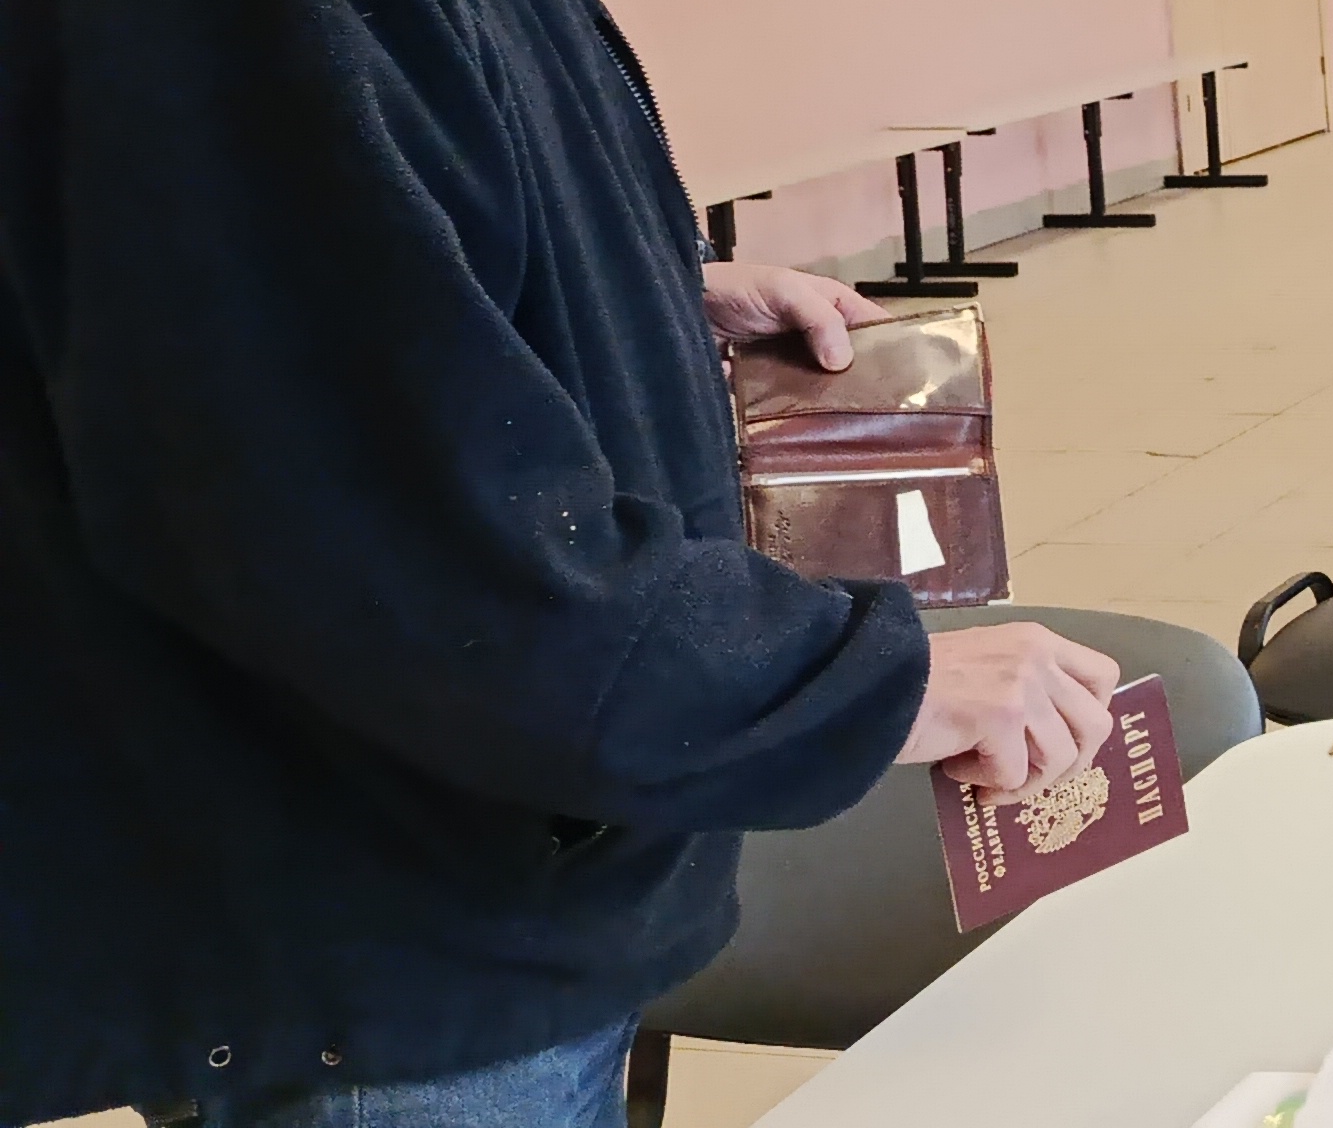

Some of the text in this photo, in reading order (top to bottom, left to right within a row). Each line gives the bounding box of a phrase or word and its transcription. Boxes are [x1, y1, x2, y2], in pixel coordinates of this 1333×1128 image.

[1119, 711, 1164, 826] ПАСПОРТ
[959, 782, 993, 893] РОССИЙСКАЯ
[982, 804, 1007, 879] ФЕДЕРАЦ
